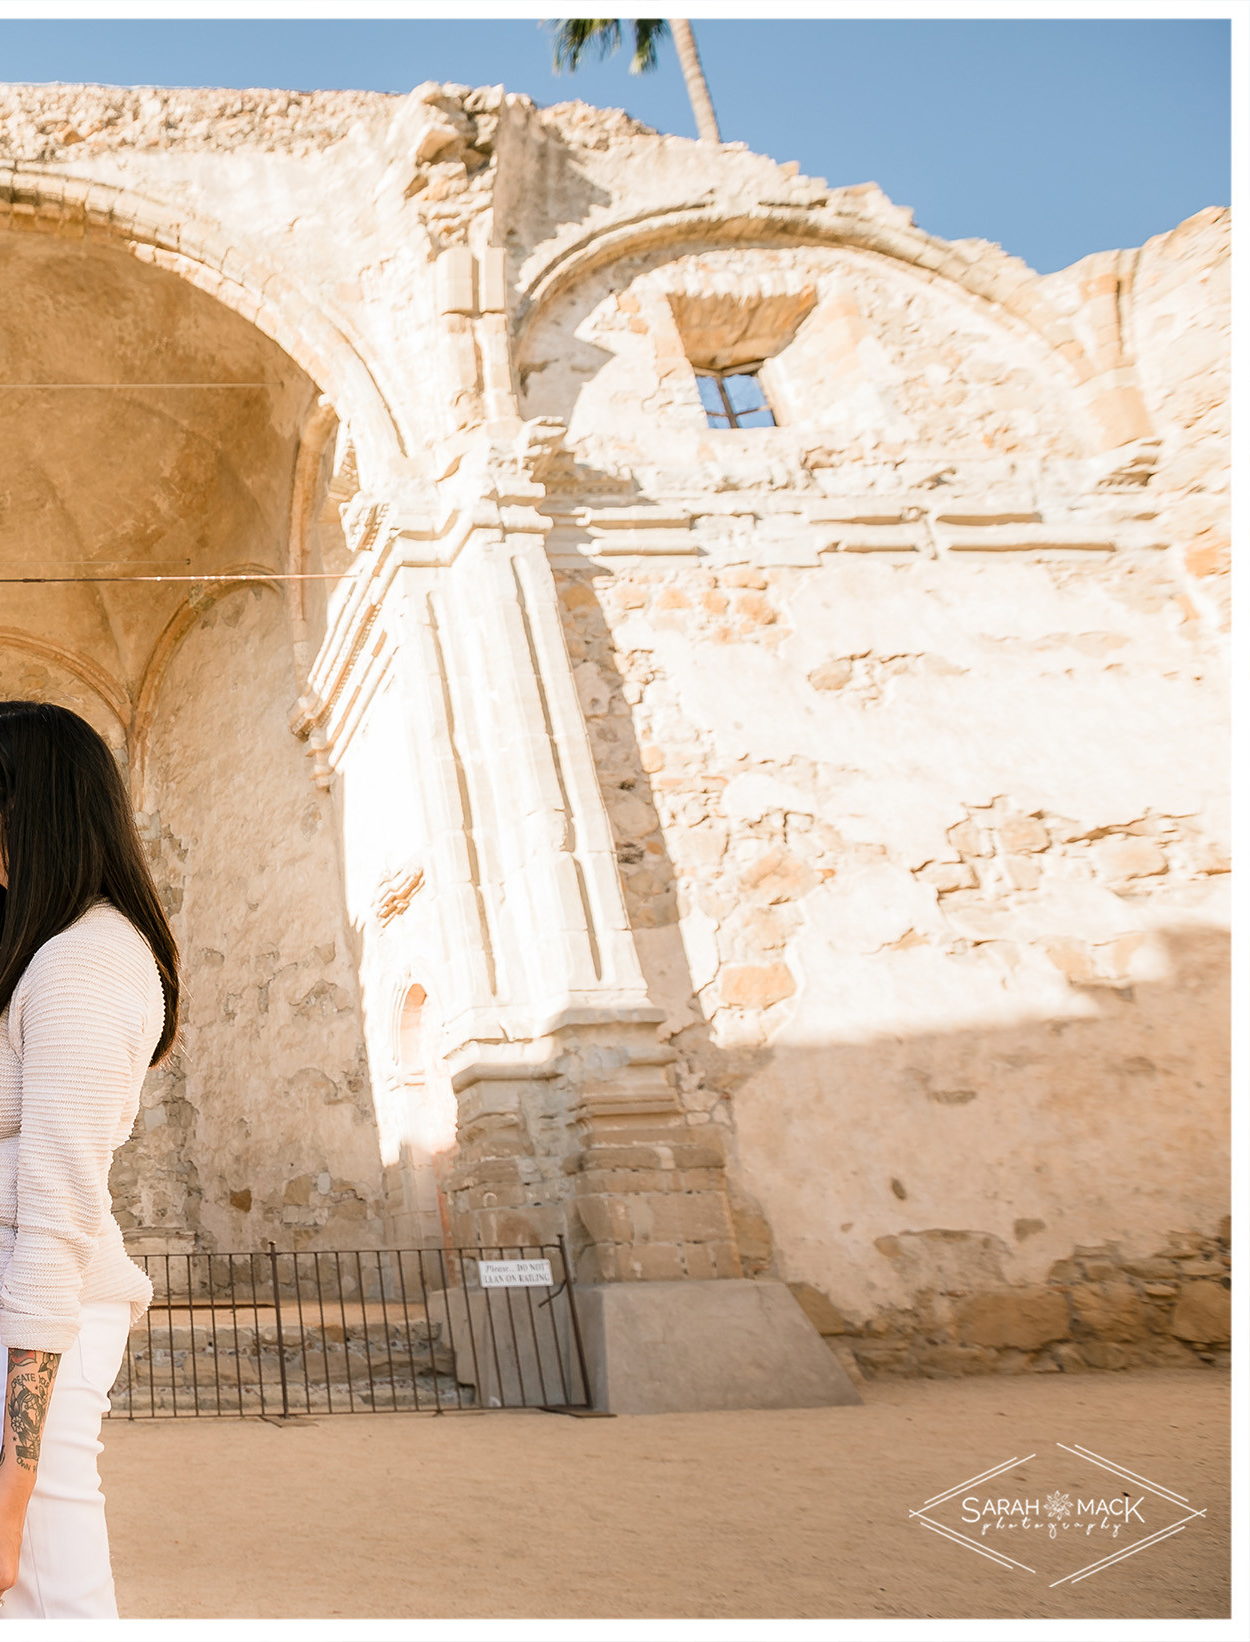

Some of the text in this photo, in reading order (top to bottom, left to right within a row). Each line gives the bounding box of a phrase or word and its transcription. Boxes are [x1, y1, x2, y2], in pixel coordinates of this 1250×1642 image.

[517, 1263, 528, 1272] DO
[529, 1263, 545, 1271] NOT
[484, 1273, 550, 1284] LEAN ON RAILING
